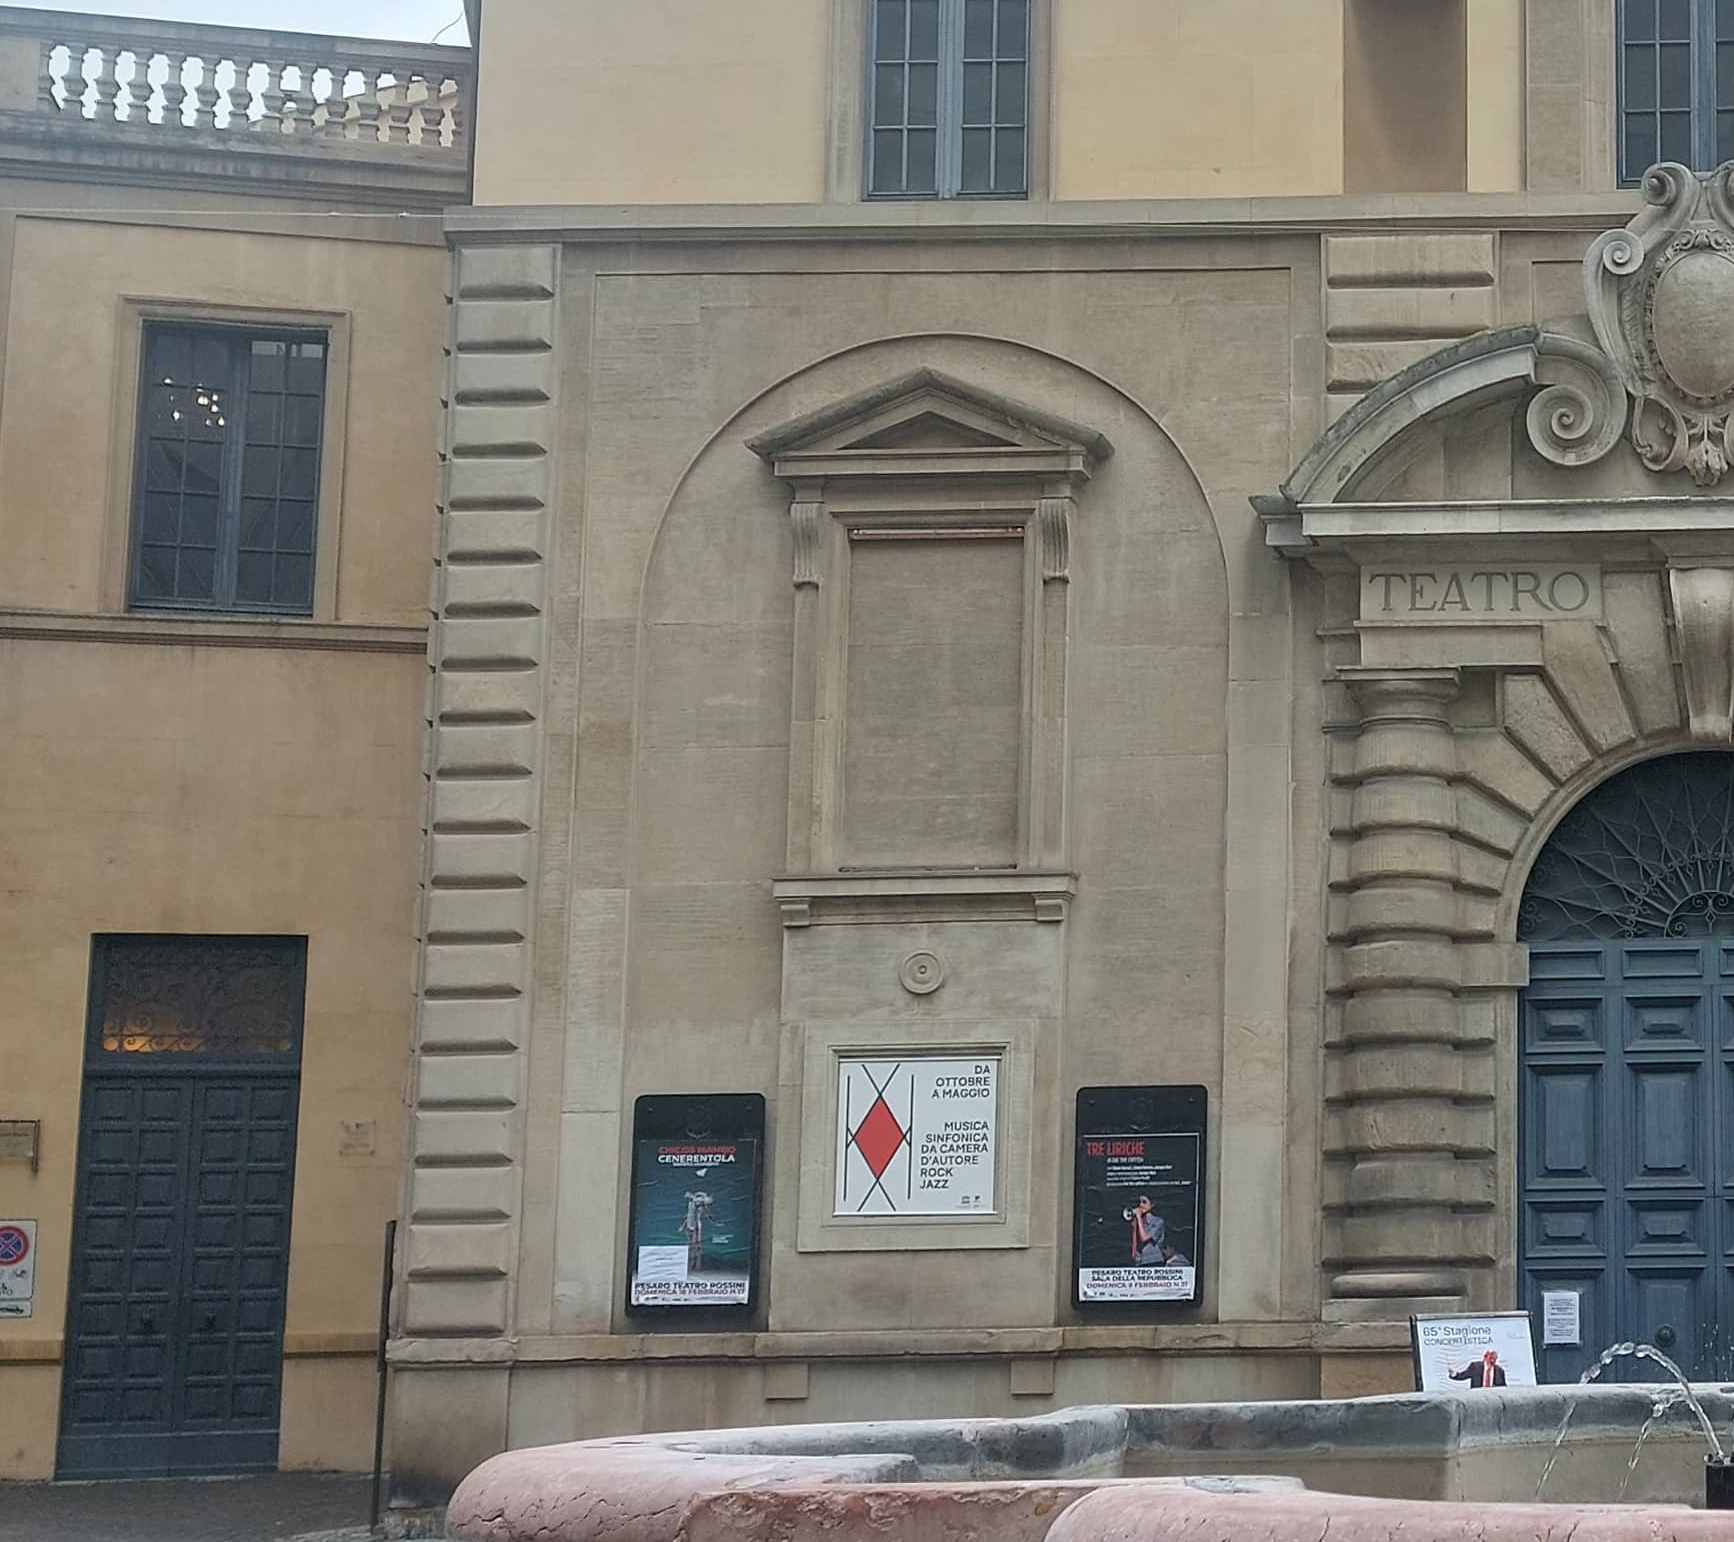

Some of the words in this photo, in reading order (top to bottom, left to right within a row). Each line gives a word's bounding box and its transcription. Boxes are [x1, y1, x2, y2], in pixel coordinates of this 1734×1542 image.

[1369, 570, 1590, 612] TEATRO
[974, 1065, 991, 1075] DA
[936, 1077, 991, 1087] OTTOBRE
[931, 1089, 940, 1099] A
[942, 1088, 990, 1098] MAGGIO
[944, 1121, 989, 1132] MUSICA
[925, 1133, 989, 1144] SINFONICA
[921, 1144, 937, 1155] DA
[939, 1143, 989, 1154] CAMERA
[1087, 1141, 1105, 1156] TRE
[1106, 1140, 1145, 1156] LIRICHE
[657, 1154, 736, 1163] CENERENTOLA
[920, 1155, 980, 1166] D'AUTORE
[919, 1167, 954, 1178] ROCK
[919, 1179, 950, 1190] JAZZ
[634, 1282, 671, 1290] PESARO
[671, 1282, 708, 1290] TEATRO
[709, 1281, 745, 1289] ROSSINI
[1443, 1325, 1492, 1338] Stagione
[1423, 1336, 1494, 1346] CONCERTISTICA
